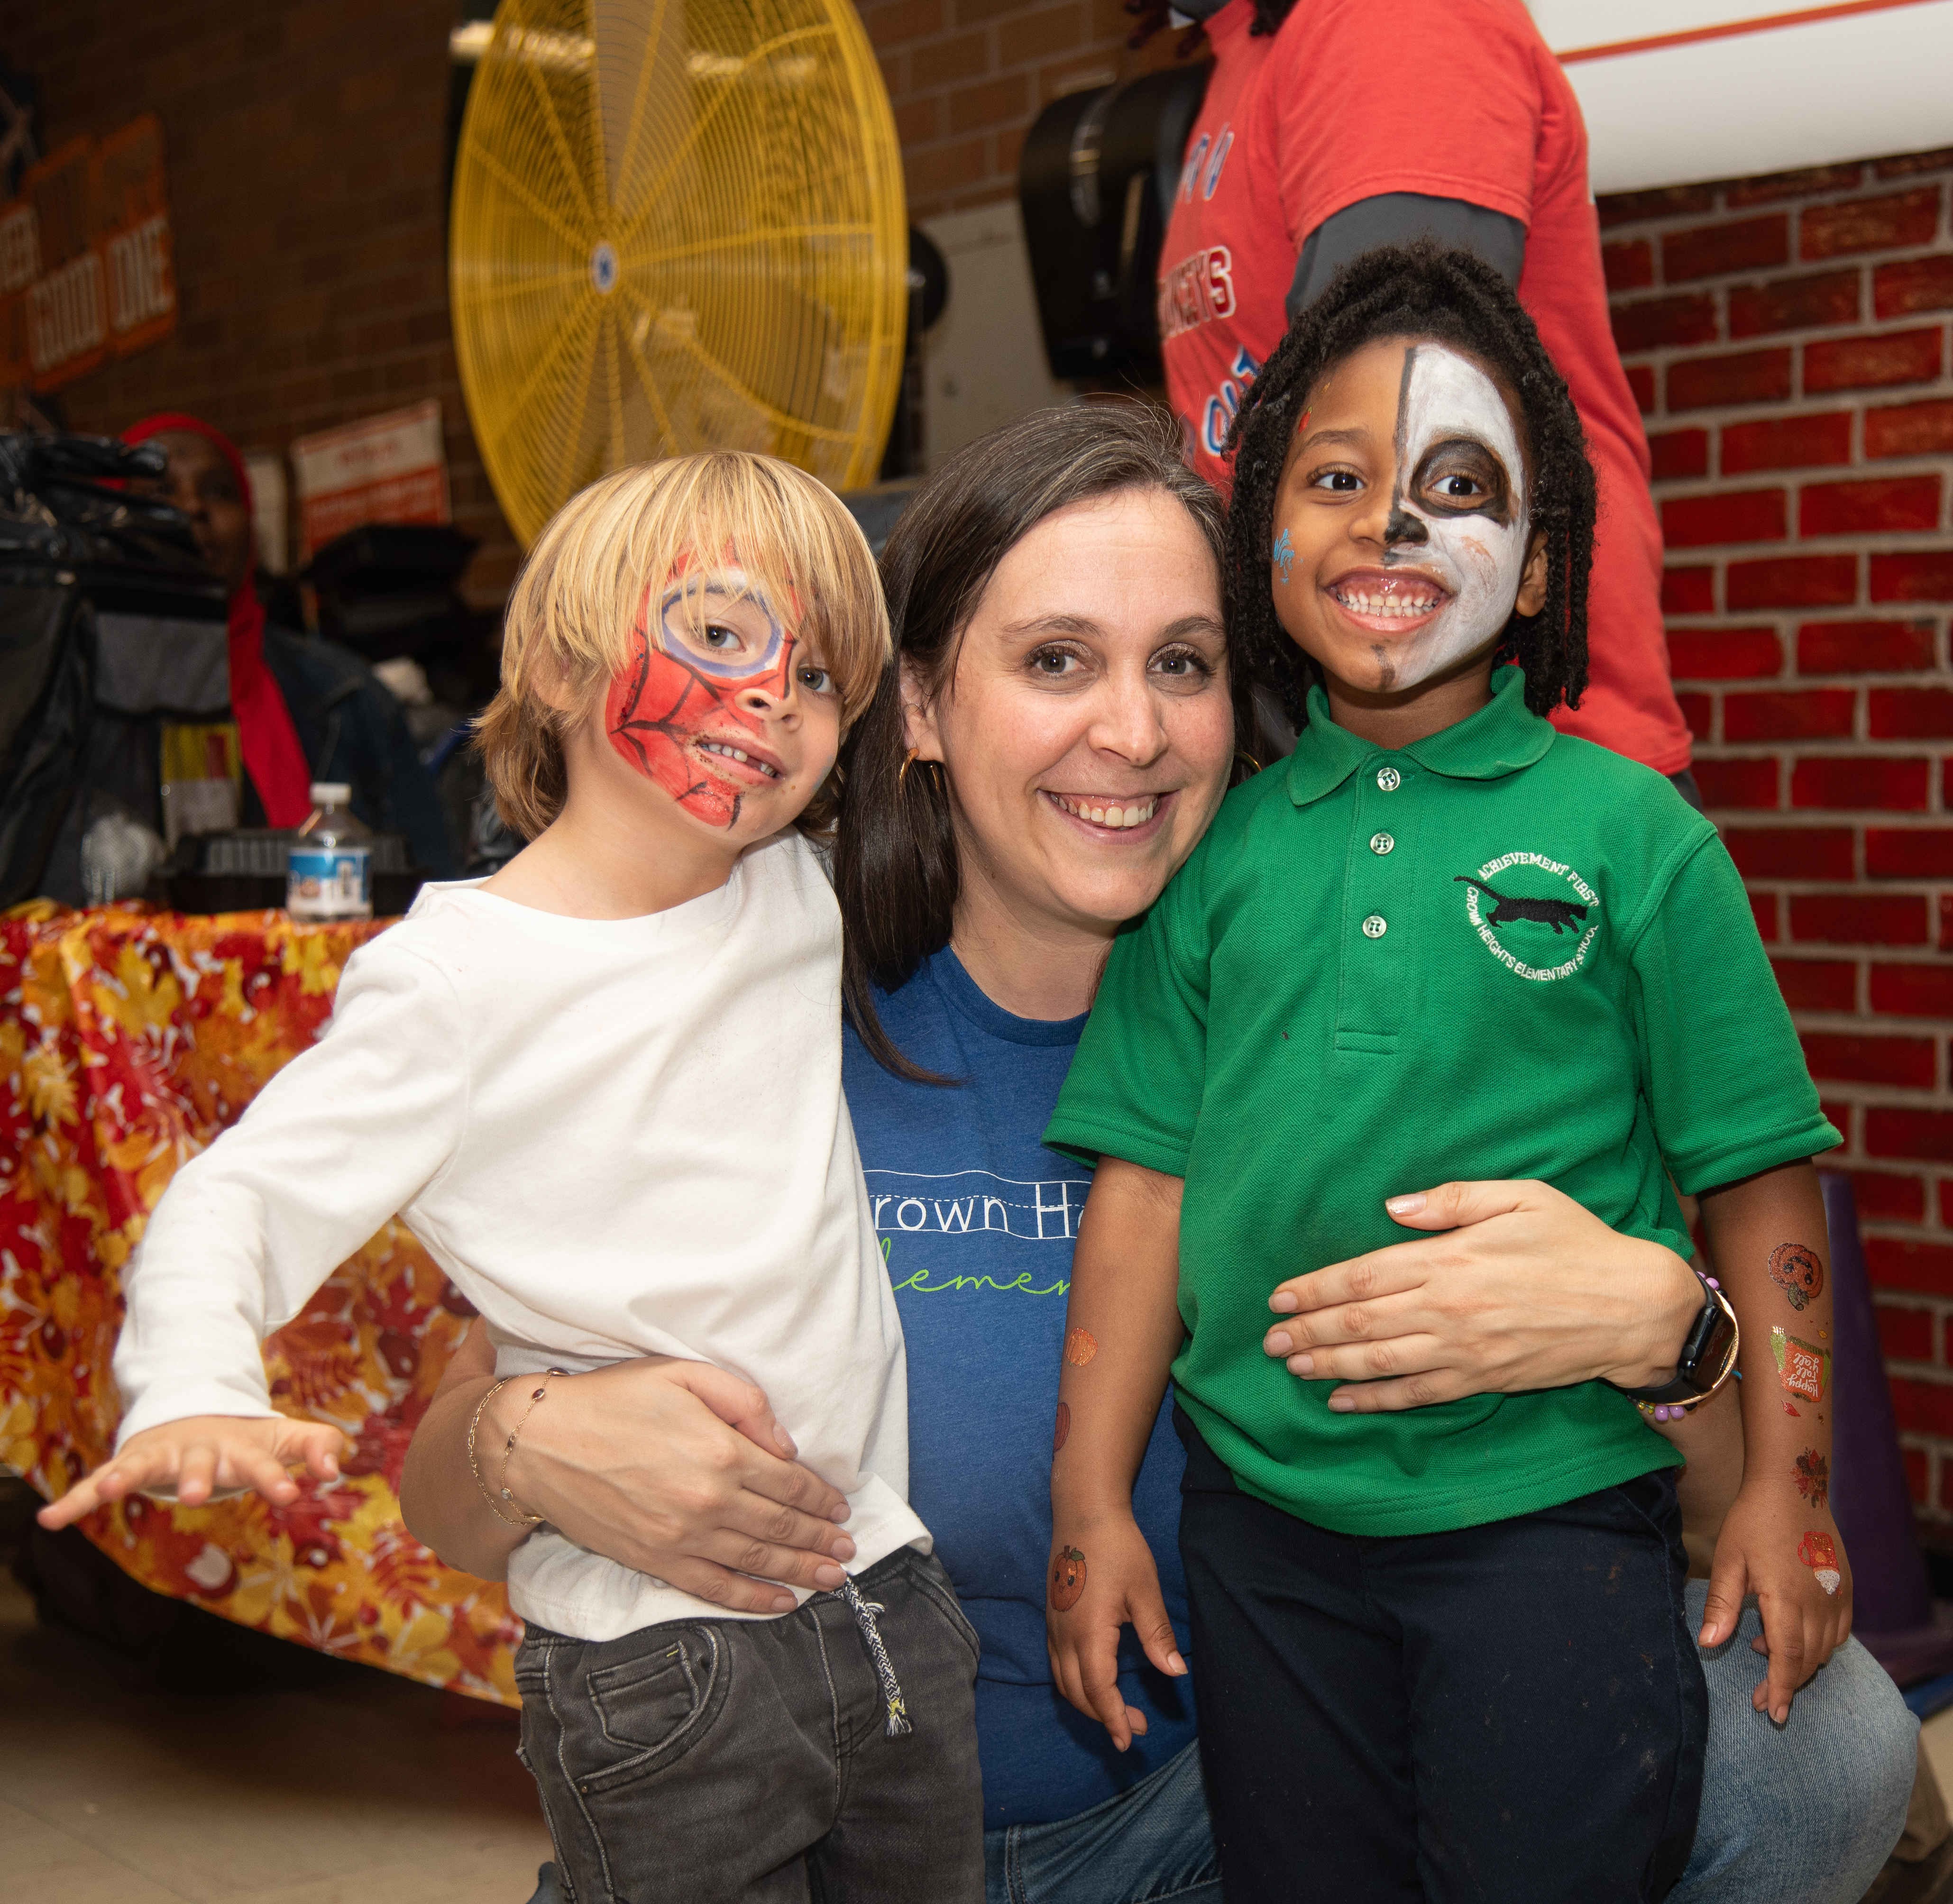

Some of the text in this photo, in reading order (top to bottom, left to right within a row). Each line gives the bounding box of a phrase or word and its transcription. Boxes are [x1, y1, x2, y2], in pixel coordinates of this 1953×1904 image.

[105, 212, 175, 334] ONE
[1477, 852, 1600, 907] ACHIEVEMENT FIRST
[1467, 886, 1484, 926] CROWN
[1477, 924, 1516, 968] HEIGHTS
[1513, 958, 1578, 981] ELEMENTARY
[875, 1182, 1085, 1239] rown H
[1787, 1374, 1818, 1398] Happy
[1796, 1364, 1817, 1382] Fall
